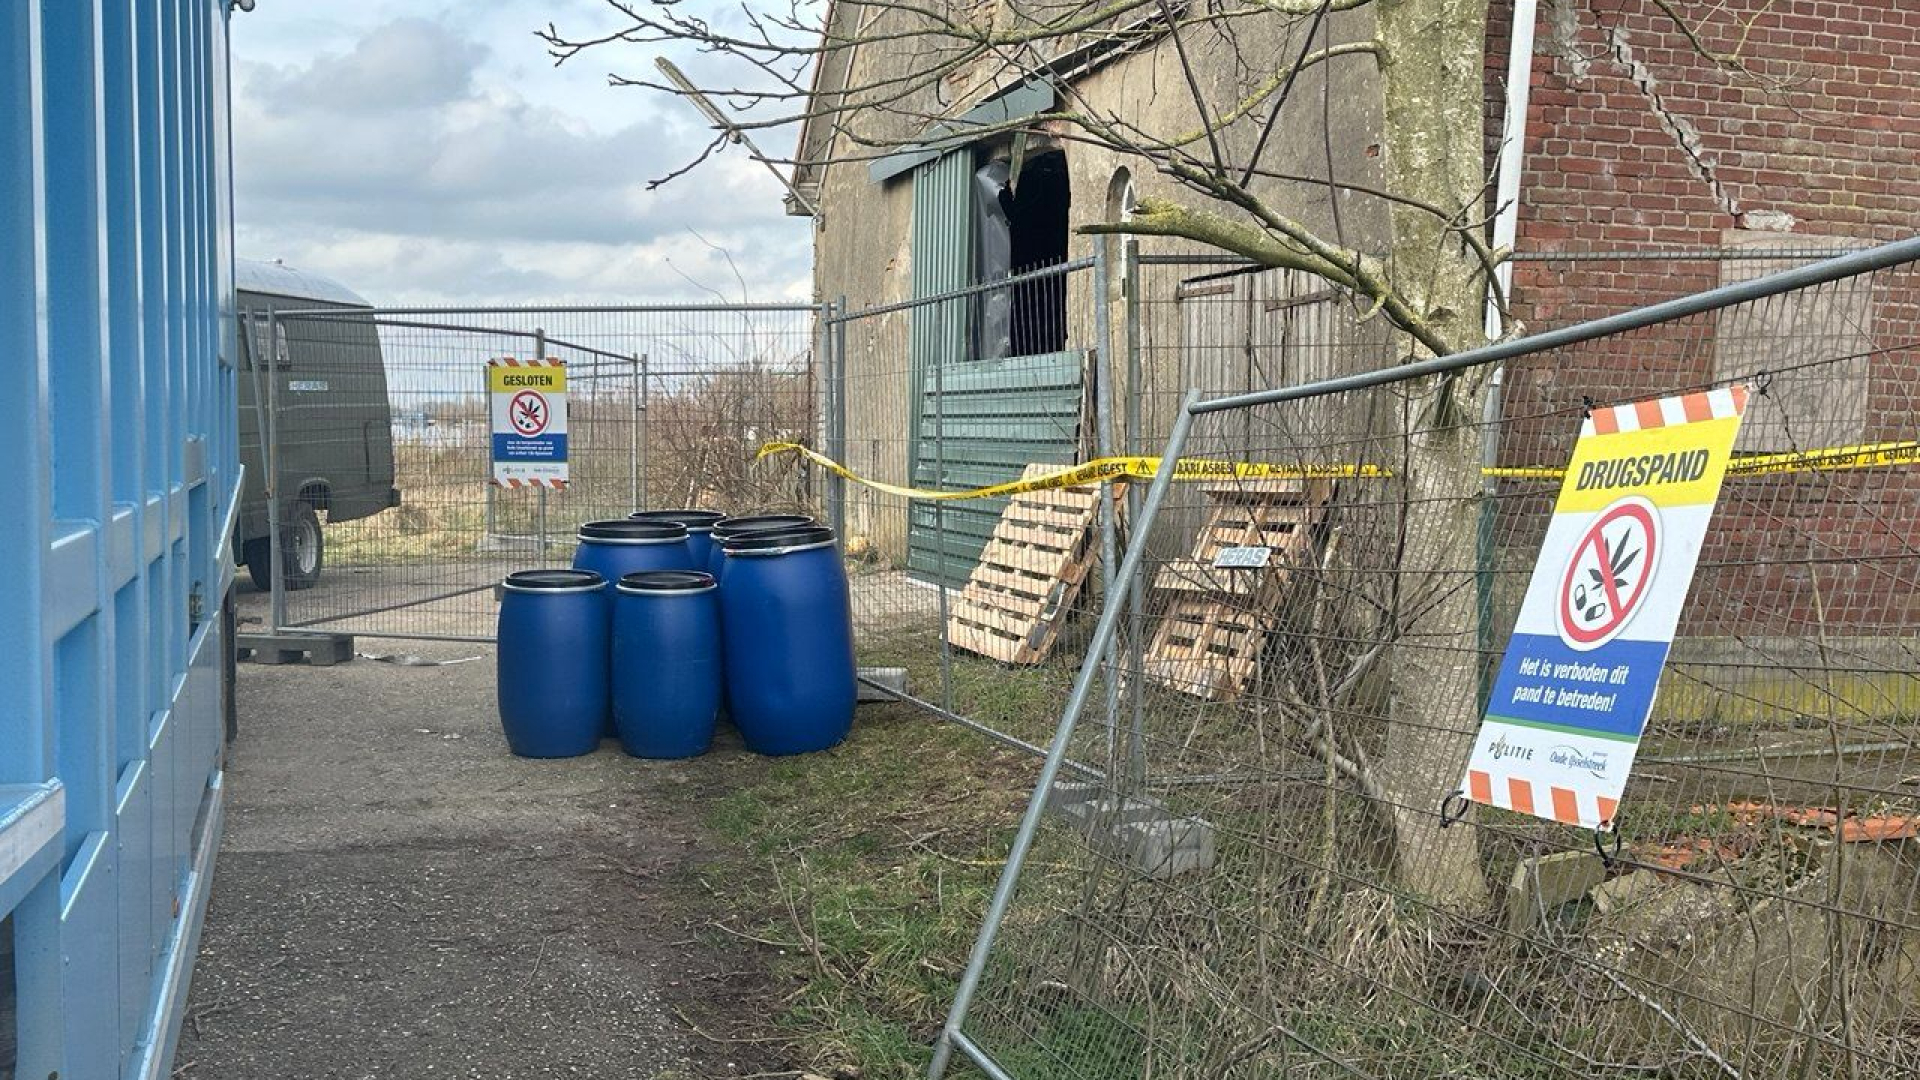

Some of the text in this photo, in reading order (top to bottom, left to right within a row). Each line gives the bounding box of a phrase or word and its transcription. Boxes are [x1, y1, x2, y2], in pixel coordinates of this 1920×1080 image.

[503, 374, 553, 387] GESLOTEN
[1576, 449, 1709, 491] DRUGSPAND
[1217, 547, 1267, 565] HERAS
[1519, 657, 1629, 684] Het is verboden dit
[1512, 686, 1616, 711] pand te betreden!
[1549, 751, 1568, 766] Oude
